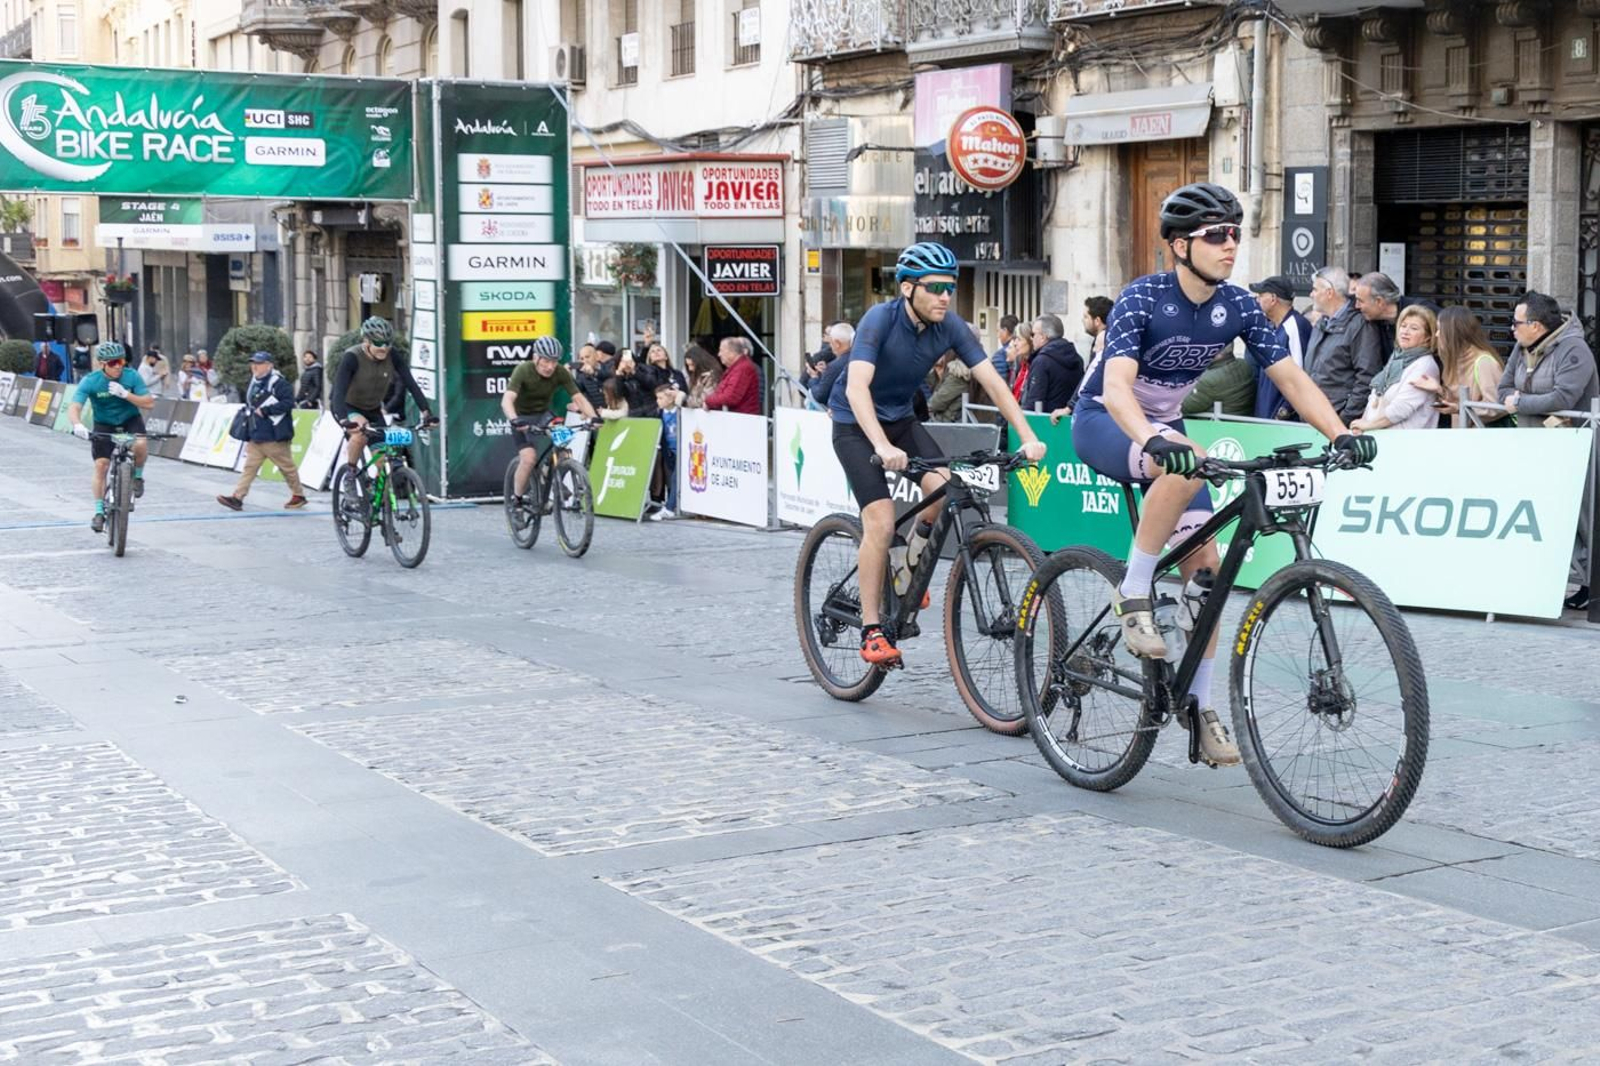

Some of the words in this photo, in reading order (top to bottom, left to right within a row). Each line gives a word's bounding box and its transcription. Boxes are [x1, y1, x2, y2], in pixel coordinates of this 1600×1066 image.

[52, 87, 233, 135] Andalucía
[252, 112, 282, 125] UCI
[287, 113, 311, 126] SHC
[454, 117, 518, 136] Andalucía
[56, 129, 134, 161] BIKE
[143, 132, 235, 164] RACE
[255, 145, 317, 157] GARMIN
[960, 135, 1020, 155] Mahou
[702, 167, 780, 181] OPORTUNIDADES
[587, 172, 652, 198] OPORTUNIDADES
[657, 170, 695, 211] JAVIER
[704, 181, 779, 201] JAVIER
[121, 201, 166, 211] STAGE
[170, 202, 181, 211] 4
[587, 200, 609, 211] TODO
[612, 200, 623, 211] EN
[626, 199, 653, 210] TELAS
[704, 201, 731, 210] TODO
[734, 201, 747, 210] EN
[750, 201, 781, 210] TELAS
[213, 233, 244, 242] asisa
[468, 256, 546, 269] GARMIN
[708, 249, 776, 260] OPORTUNIDADES
[712, 262, 772, 278] JAVIER
[750, 282, 775, 292] TELAS
[481, 319, 536, 332] PIRELLI
[711, 456, 761, 475] AYUNTAMIENTO
[1056, 462, 1093, 486] CAJA
[711, 473, 720, 486] DE
[1275, 471, 1314, 500] 55-1
[1081, 488, 1120, 515] JAÉN
[1018, 580, 1039, 631] MAXXIS
[1236, 600, 1265, 656] MAXXIS
